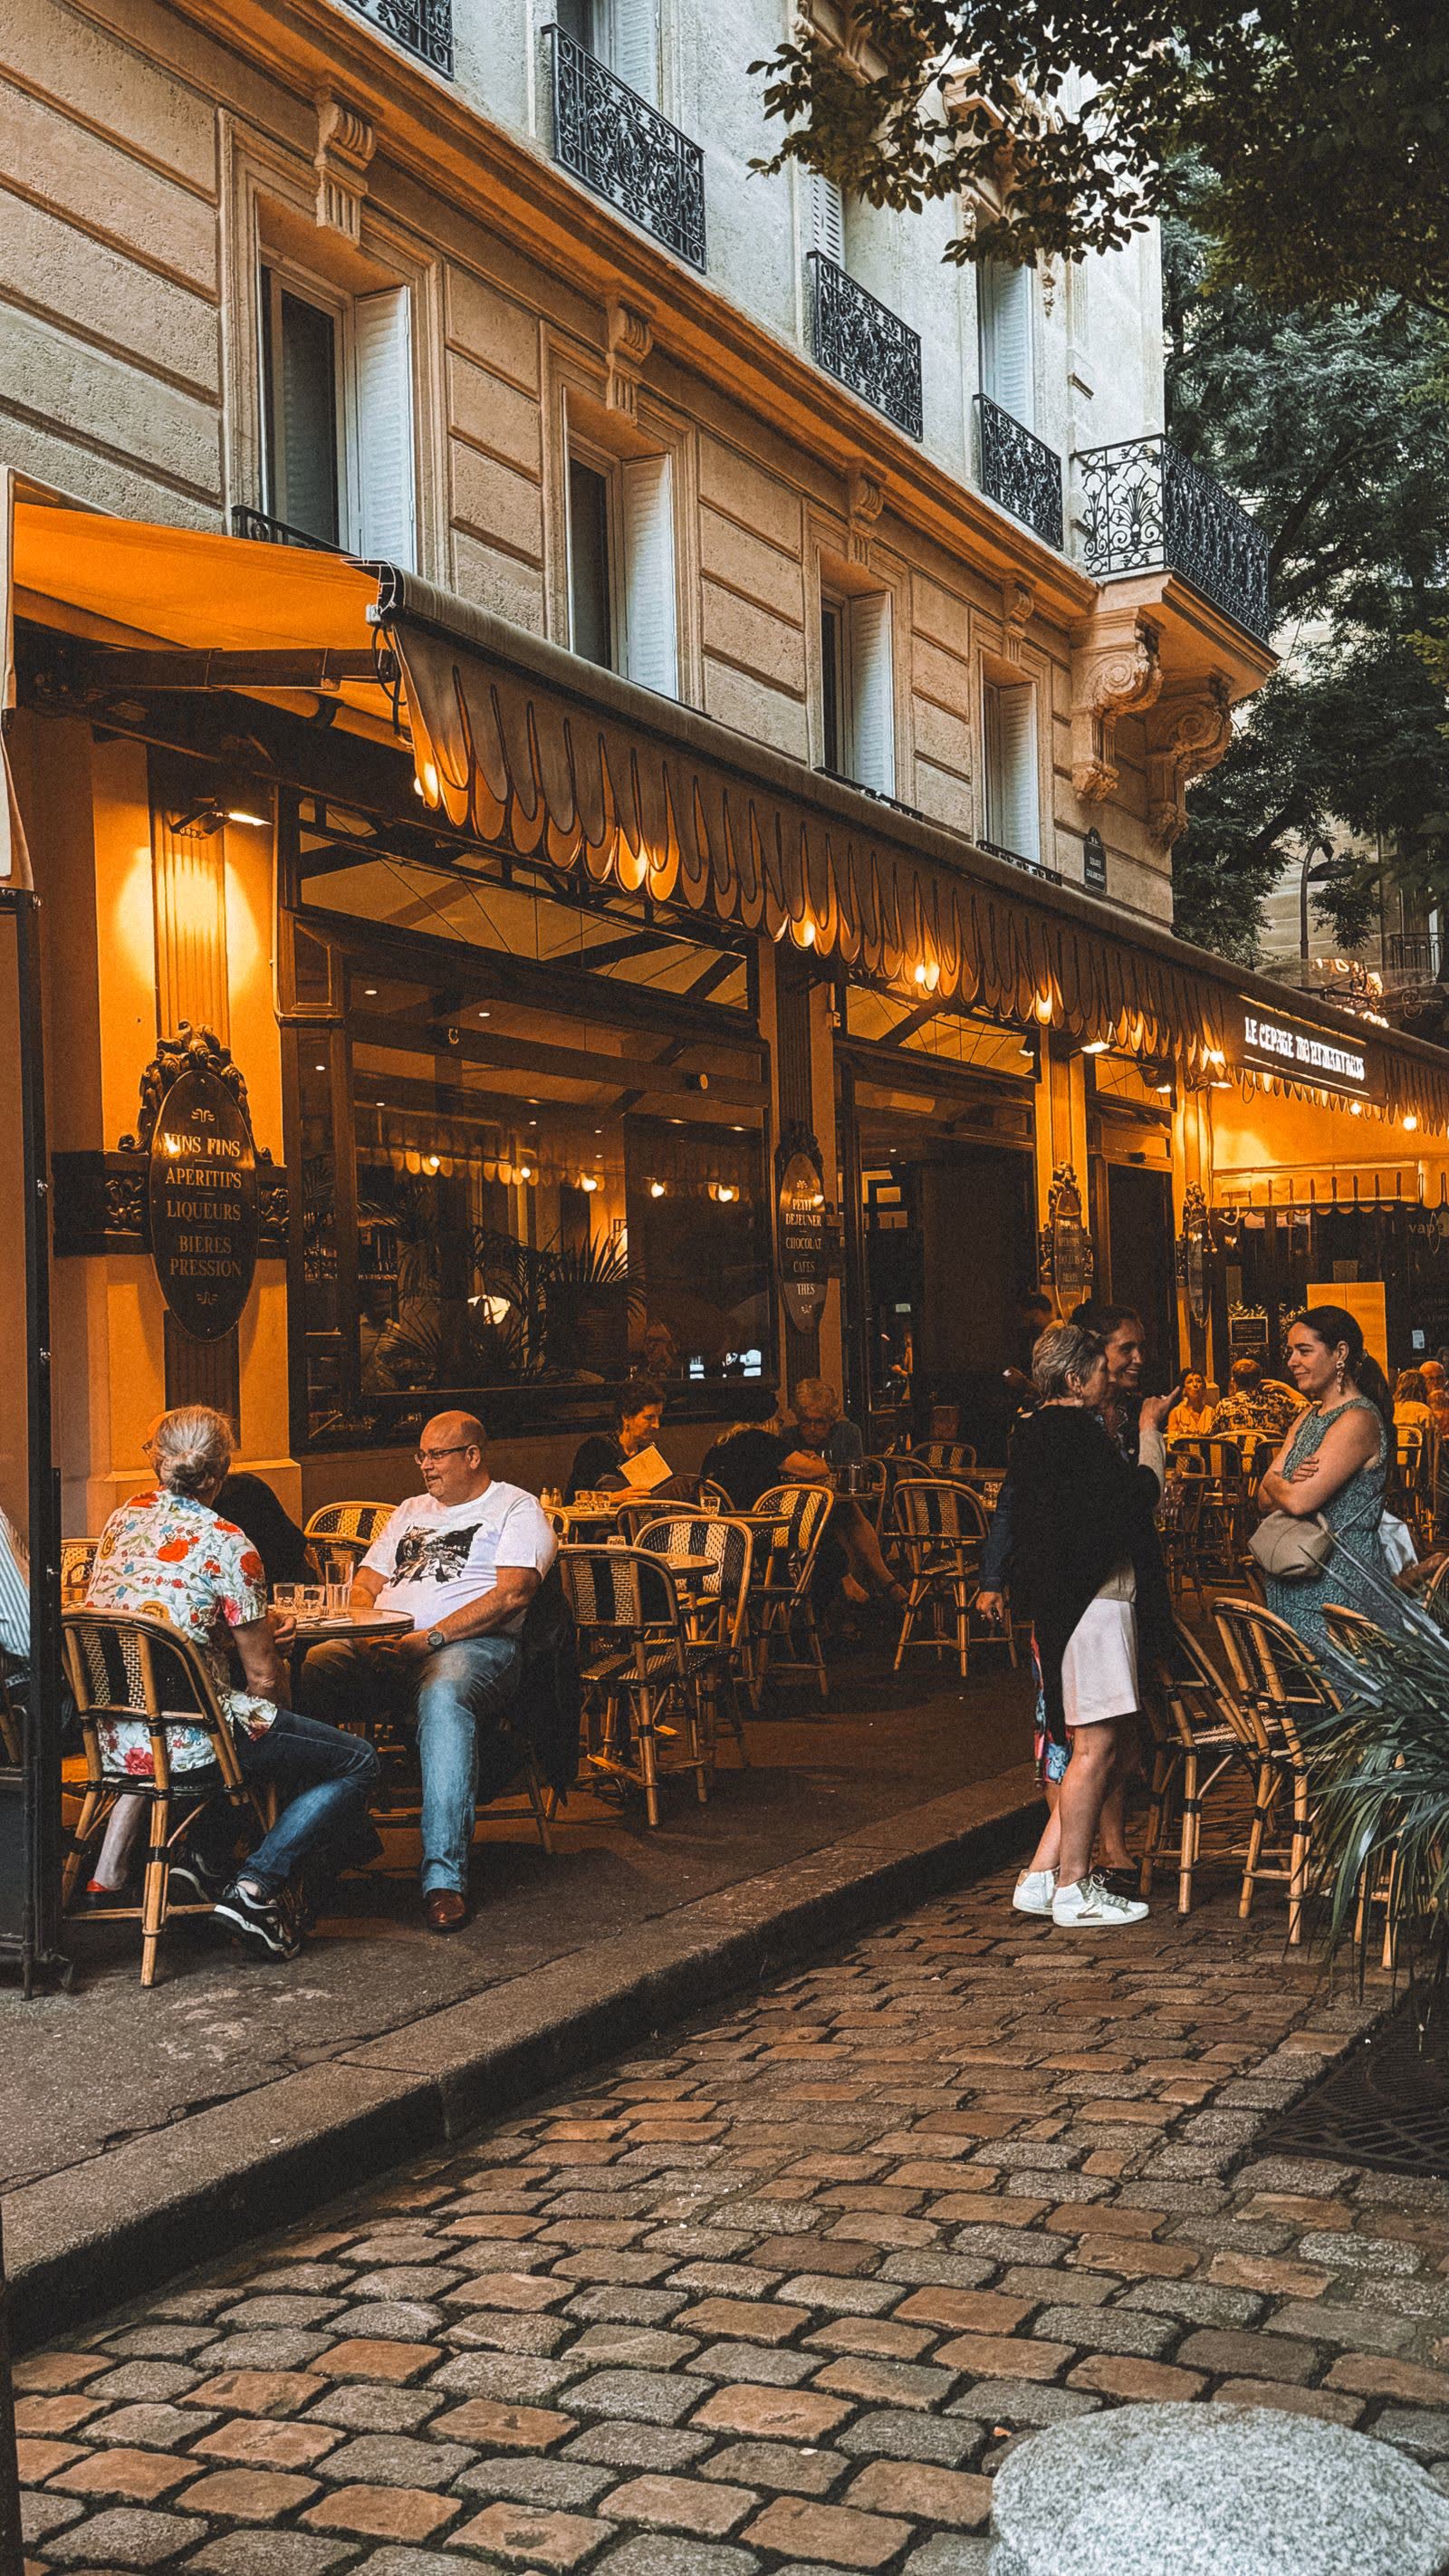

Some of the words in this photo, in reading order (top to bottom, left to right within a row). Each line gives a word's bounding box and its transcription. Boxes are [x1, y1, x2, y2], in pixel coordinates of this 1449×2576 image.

[1245, 1016, 1258, 1045] LE
[164, 1133, 201, 1154] VINS
[206, 1137, 241, 1158] FINS
[165, 1167, 242, 1189] APERITIFS
[167, 1199, 241, 1222] LIQUEURS
[792, 1198, 812, 1211] PETIT
[785, 1213, 822, 1226] DEJEUNER
[178, 1235, 232, 1254] BIERES
[785, 1236, 822, 1250] CHOCOLAT
[169, 1257, 242, 1277] PRESSION
[796, 1283, 815, 1295] THES
